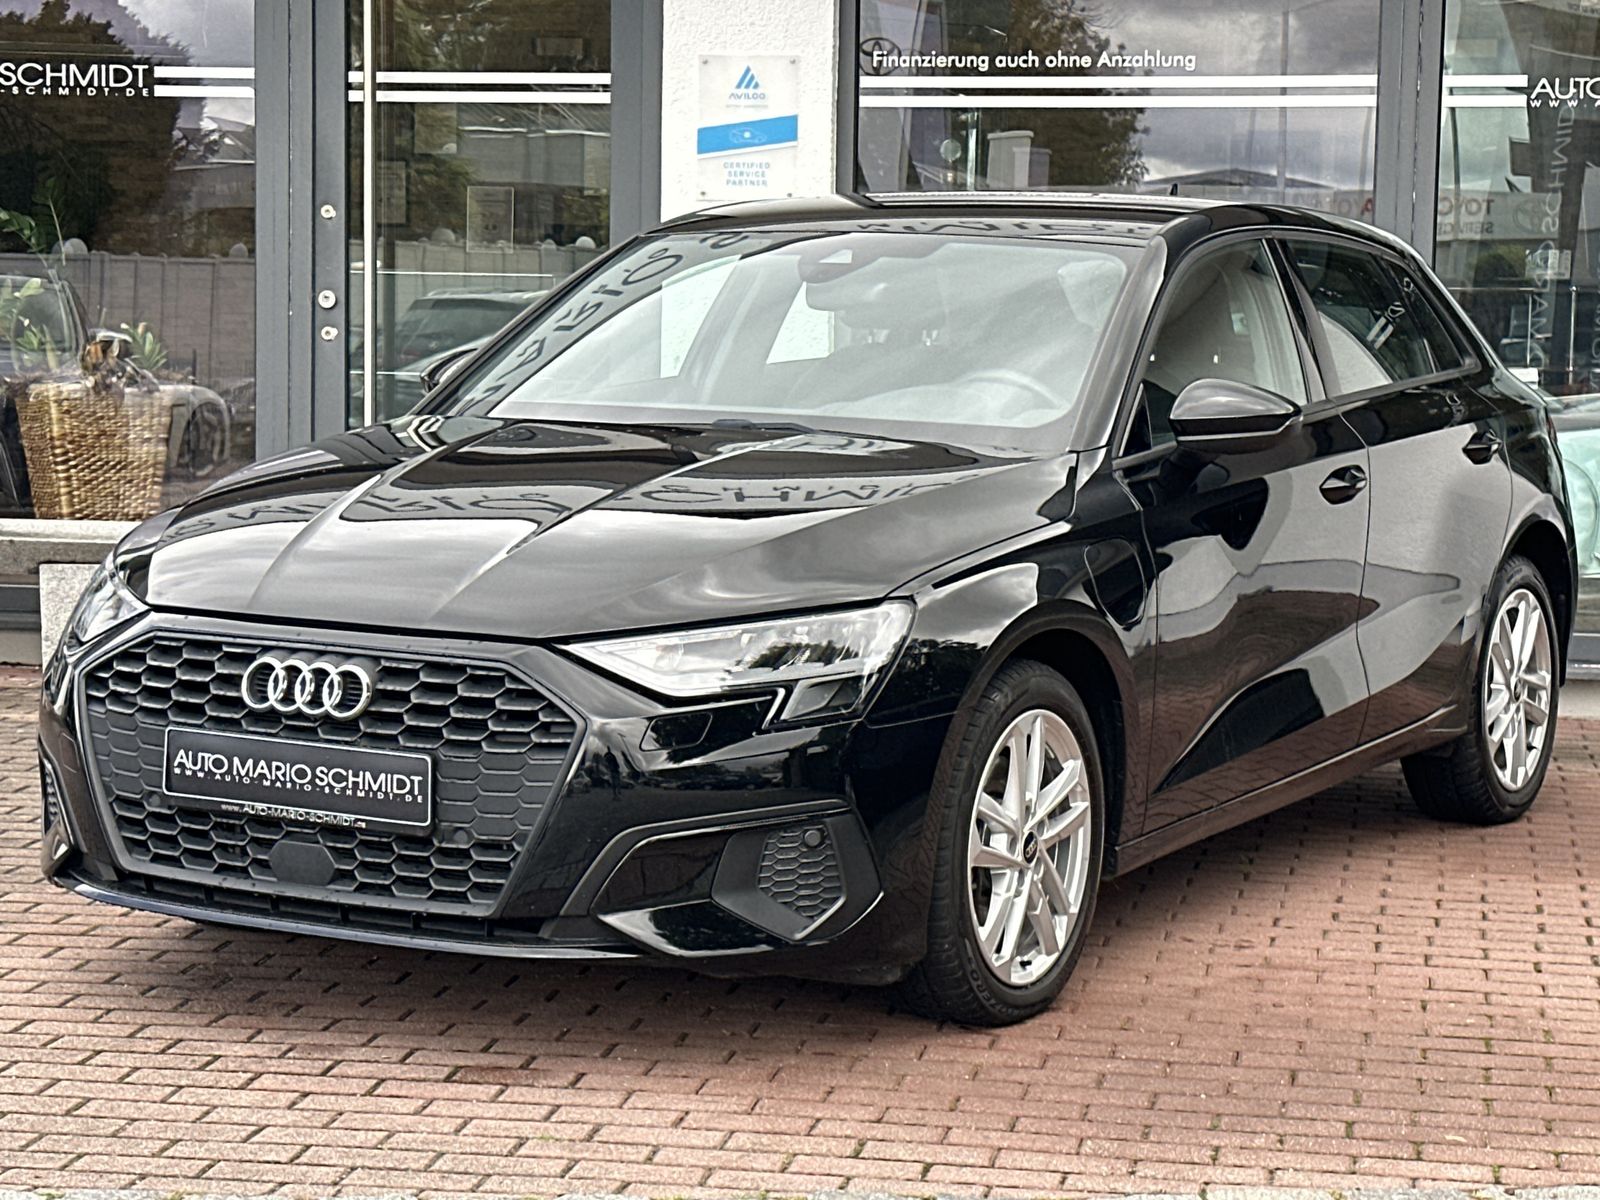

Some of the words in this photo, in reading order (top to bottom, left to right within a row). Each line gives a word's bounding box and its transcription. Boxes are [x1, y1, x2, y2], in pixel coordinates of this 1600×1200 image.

[872, 51, 989, 71] Finanzierung
[995, 50, 1039, 68] auch
[1045, 50, 1092, 68] ohne
[1097, 50, 1197, 71] Anzahlung
[0, 62, 149, 88] SCHMIDT
[729, 92, 766, 100] AVILOO
[726, 179, 768, 187] PARTNER
[173, 748, 229, 774] AUTO
[233, 756, 312, 784] MARIO
[315, 766, 423, 795] SCHMIDT
[173, 767, 424, 803] WWW.AUTO-MARIO-SCHMIDT.DE
